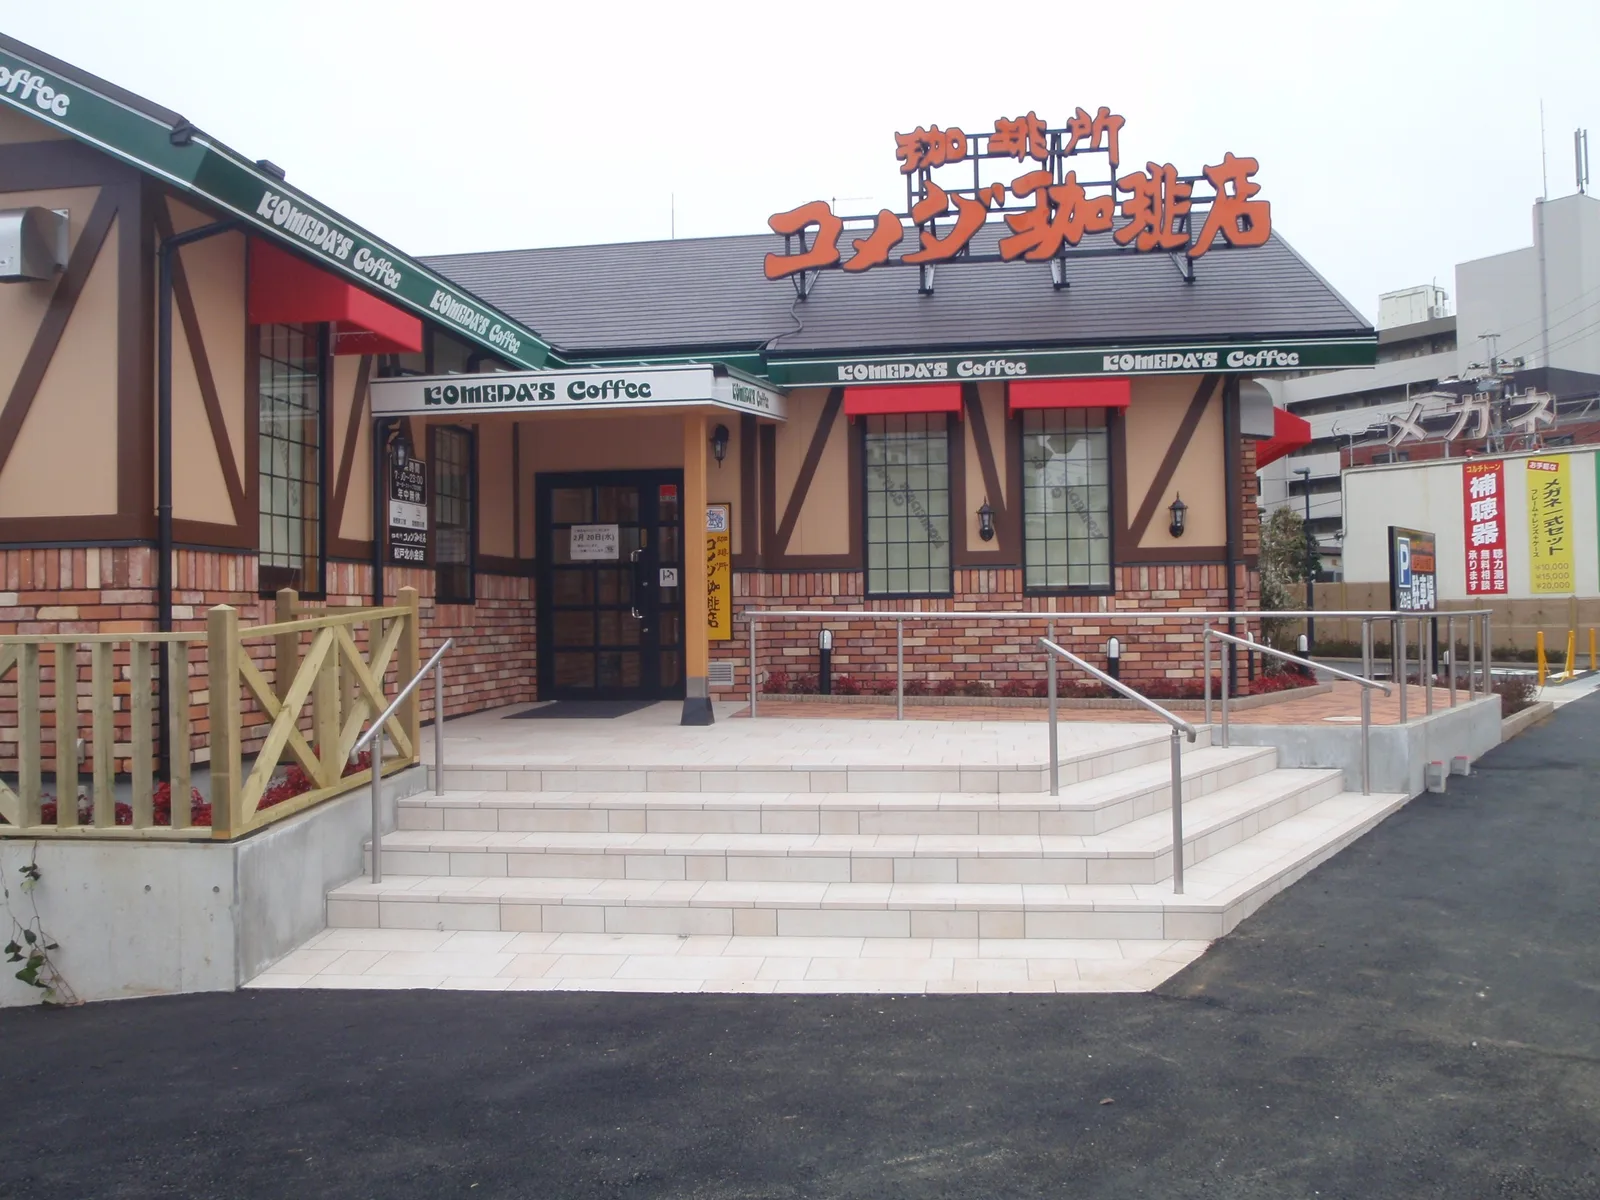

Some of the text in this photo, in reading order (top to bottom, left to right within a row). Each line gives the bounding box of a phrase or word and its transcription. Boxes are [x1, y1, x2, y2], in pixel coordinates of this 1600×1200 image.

[896, 107, 1125, 174] 珈琲所
[256, 191, 402, 289] KOMEDA'S Coffee
[763, 152, 1271, 281] コメダ珈琲店
[429, 290, 521, 354] KOMEDA'S Coffee
[837, 360, 1027, 380] KOMEDA'S Coffee
[1103, 350, 1300, 371] KOMEDA'S Coffee
[424, 379, 652, 405] KOMEDA'S Coffee
[1386, 387, 1556, 447] メガネ
[1470, 473, 1499, 546] 補聴器
[1543, 478, 1564, 556] メガネ一式セット
[1400, 543, 1409, 583] P
[1468, 549, 1478, 591] 承ります
